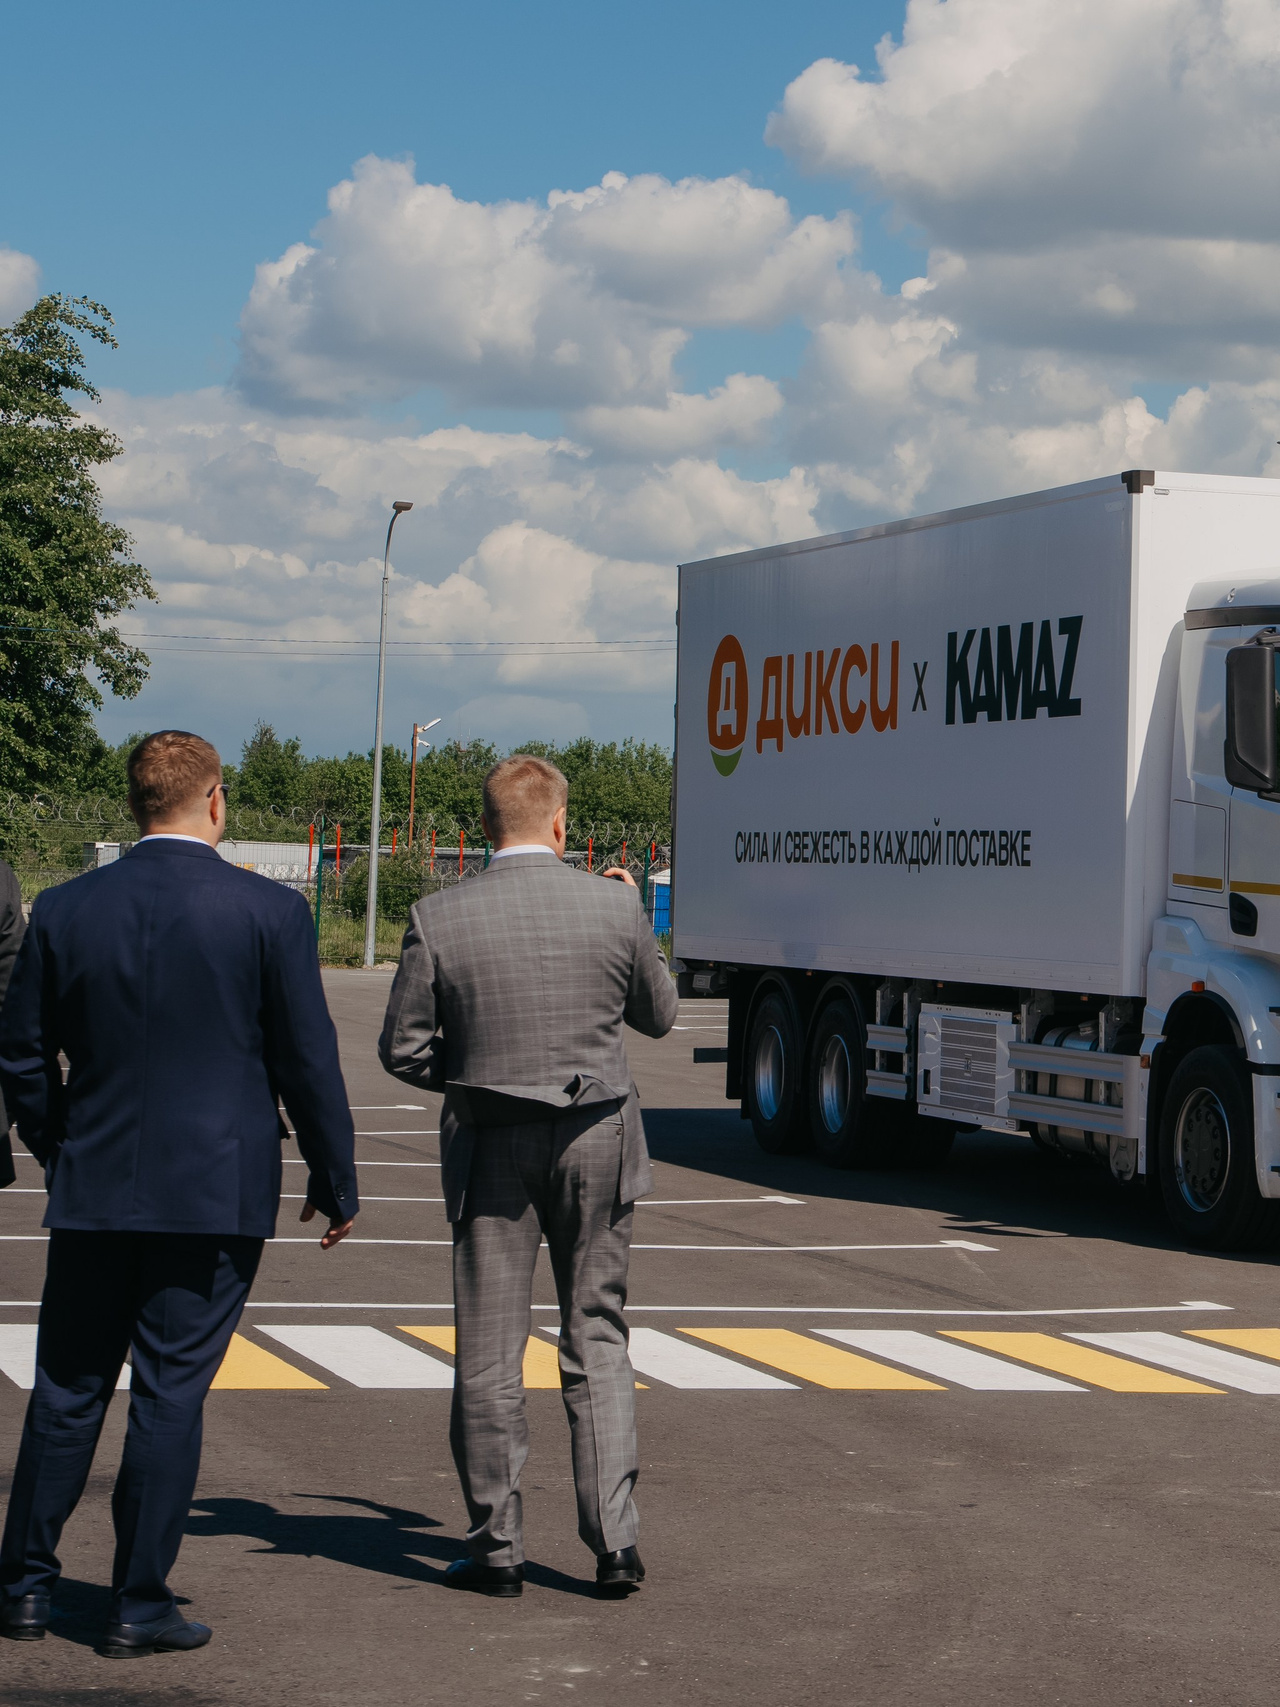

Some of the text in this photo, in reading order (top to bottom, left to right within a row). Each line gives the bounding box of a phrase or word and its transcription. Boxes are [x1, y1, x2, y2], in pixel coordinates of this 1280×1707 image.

[756, 640, 900, 754] ДИКСИ
[945, 615, 1084, 725] KAMAZ
[735, 817, 1031, 873] СИЛА И СВЕЖЕСТЬ В КАЖДОЙ ПОСТАВКЕ
